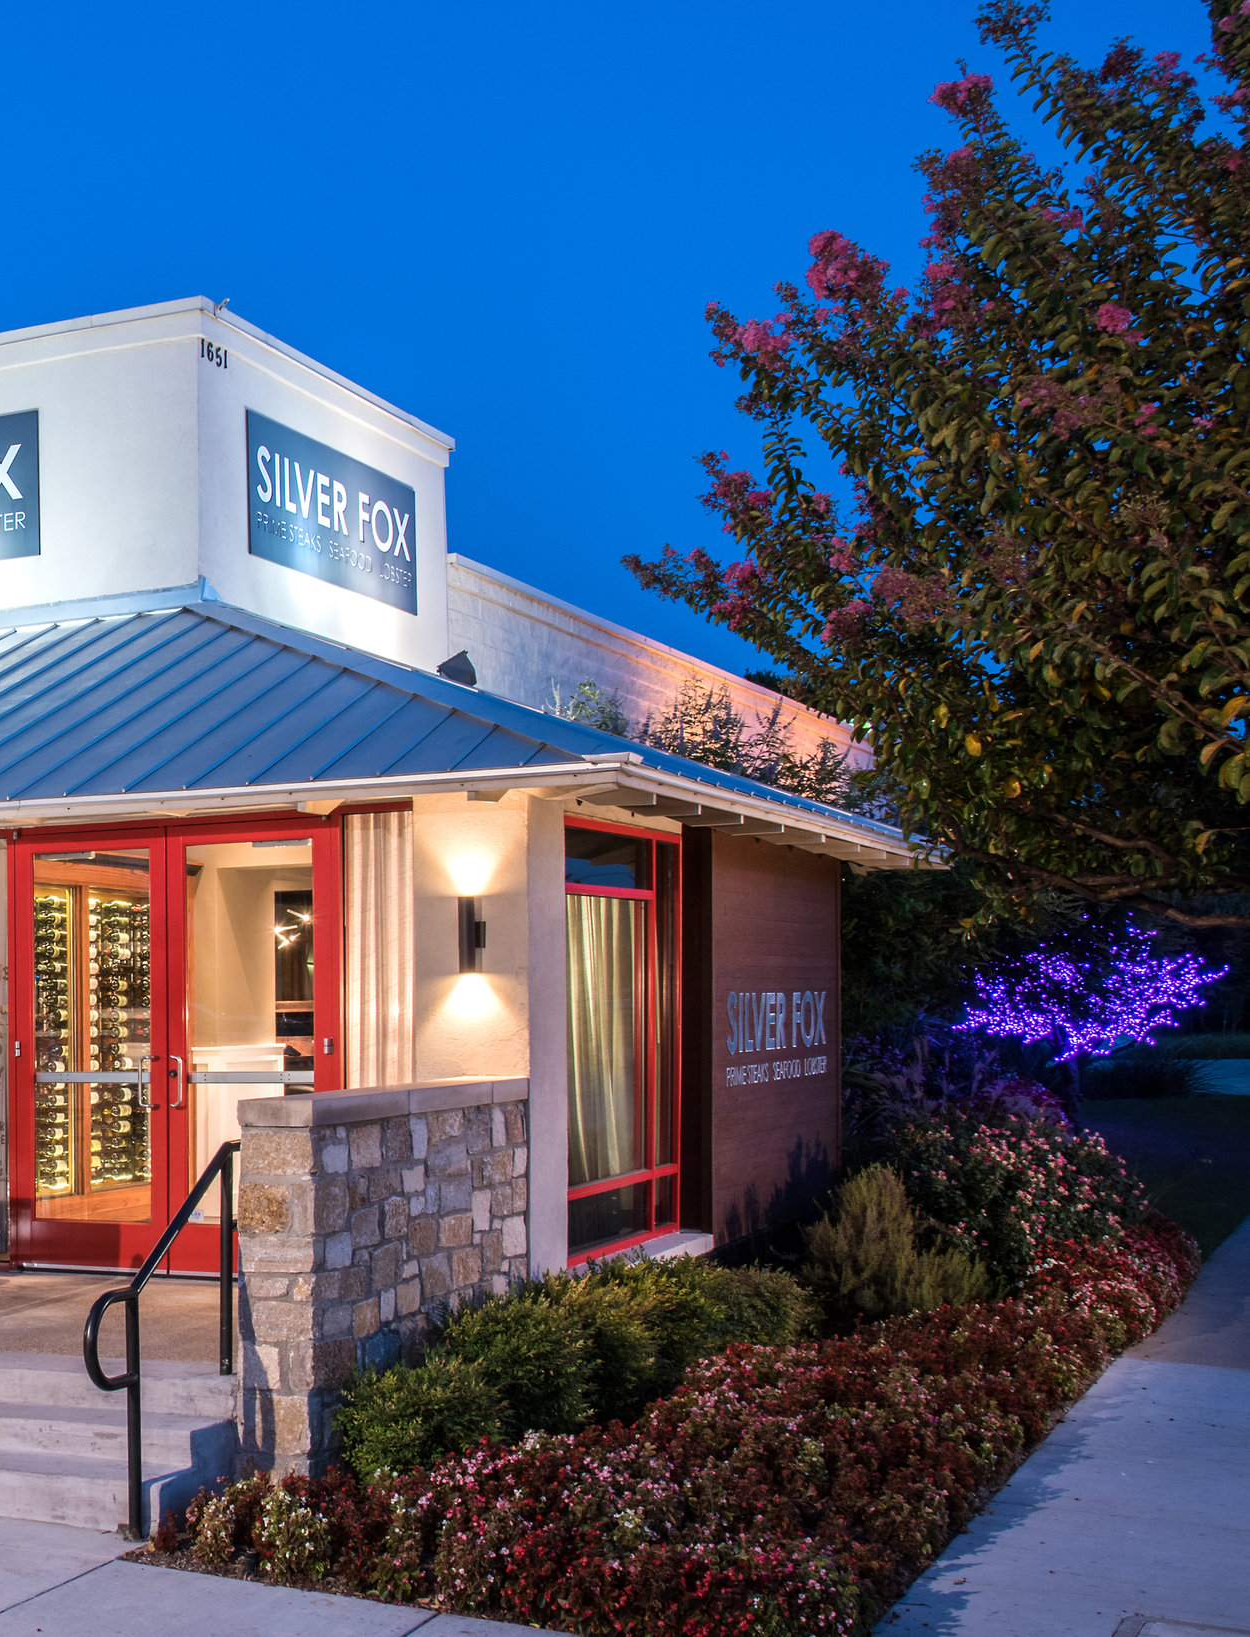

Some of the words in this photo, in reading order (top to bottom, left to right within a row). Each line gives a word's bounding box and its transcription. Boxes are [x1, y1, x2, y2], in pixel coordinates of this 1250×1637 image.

[201, 338, 228, 369] 1651
[256, 445, 349, 536] SILVER
[358, 491, 411, 562] FOX
[256, 511, 287, 540] PRIME
[289, 524, 322, 553] STEAKS
[329, 540, 372, 574] SEAFOOD
[379, 562, 412, 588] LOBSTER
[727, 991, 787, 1055] SILVER
[792, 990, 827, 1048] FOX
